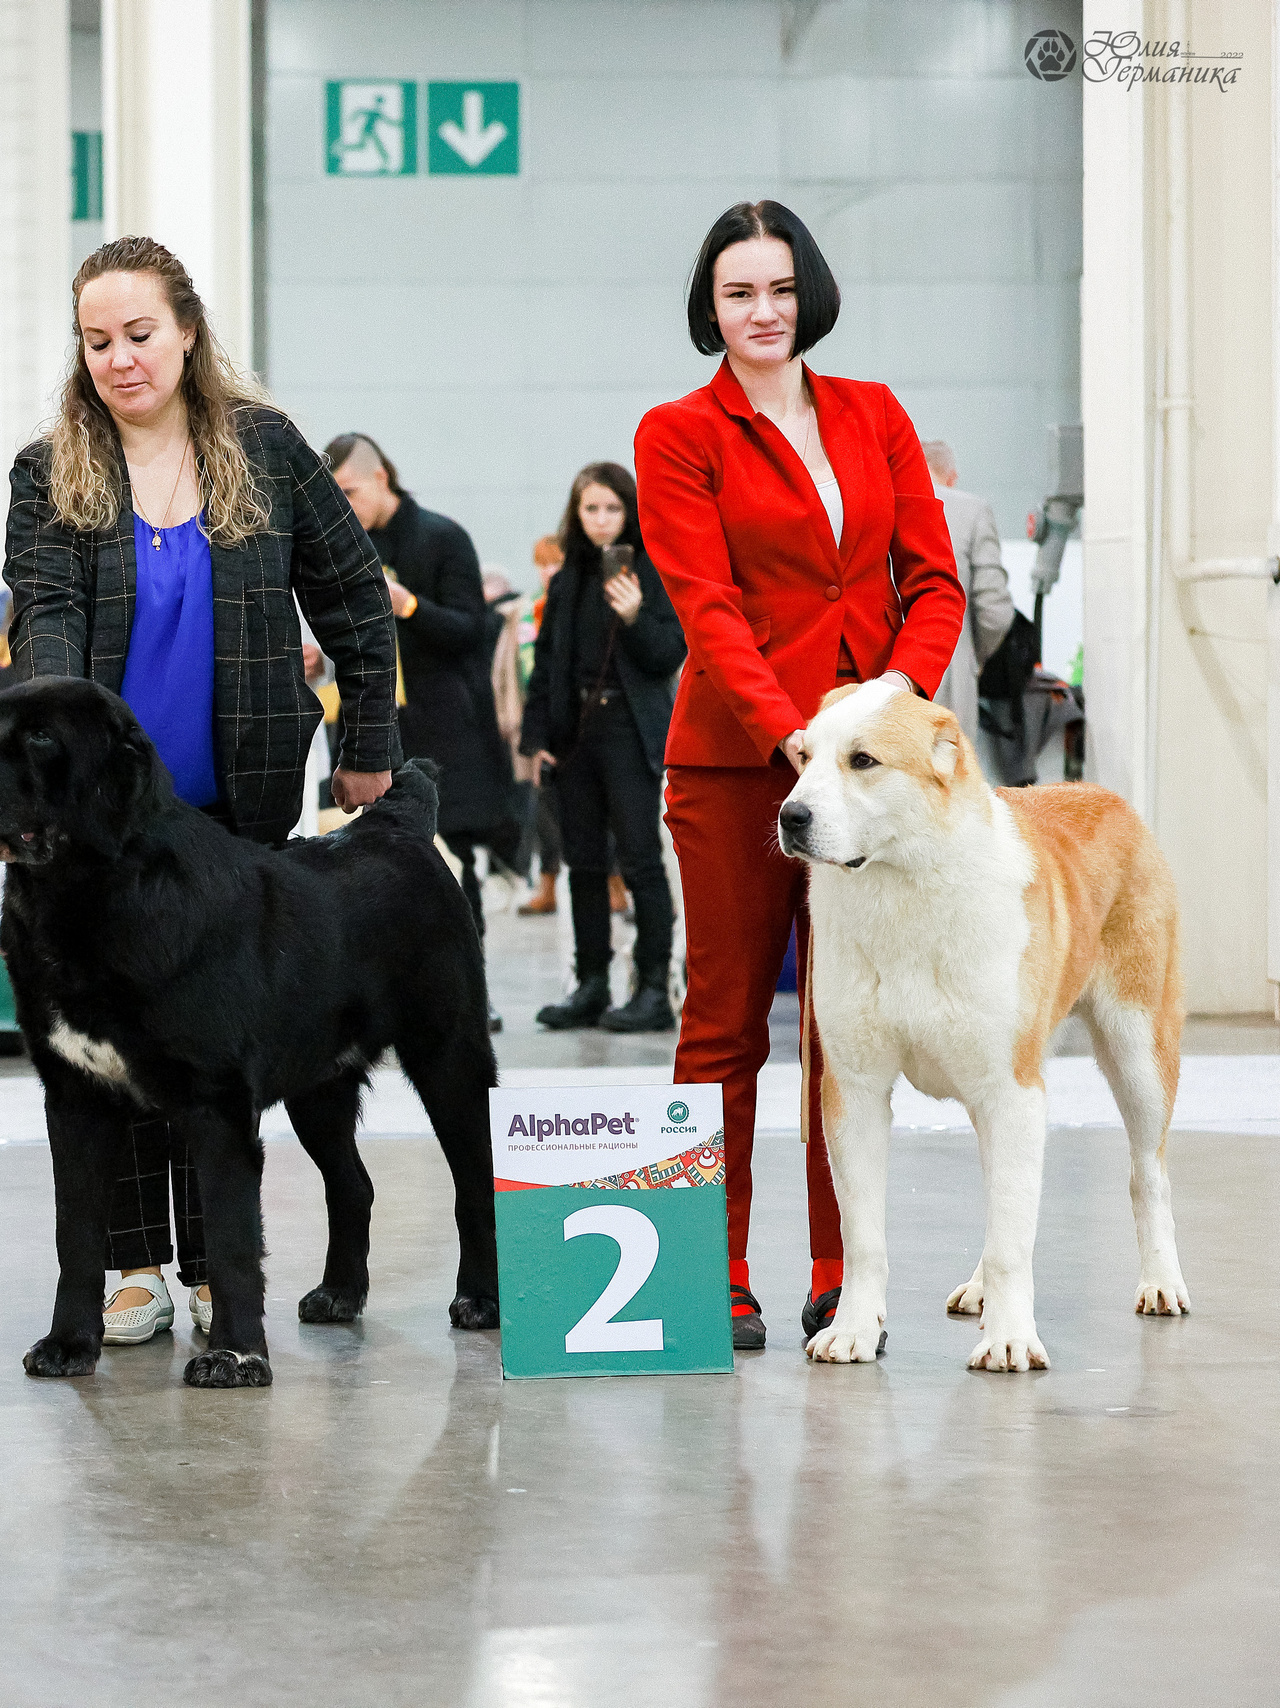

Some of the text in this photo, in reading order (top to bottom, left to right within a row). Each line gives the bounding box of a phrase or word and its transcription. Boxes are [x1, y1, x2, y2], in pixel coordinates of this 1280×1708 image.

[507, 1112, 636, 1142] AlphaPet
[661, 1125, 697, 1134] РОССИЯ
[508, 1141, 639, 1152] ПРОФЕССИОНАЛЬНЫЕ РАЦИОНЫ
[563, 1204, 664, 1354] 2
